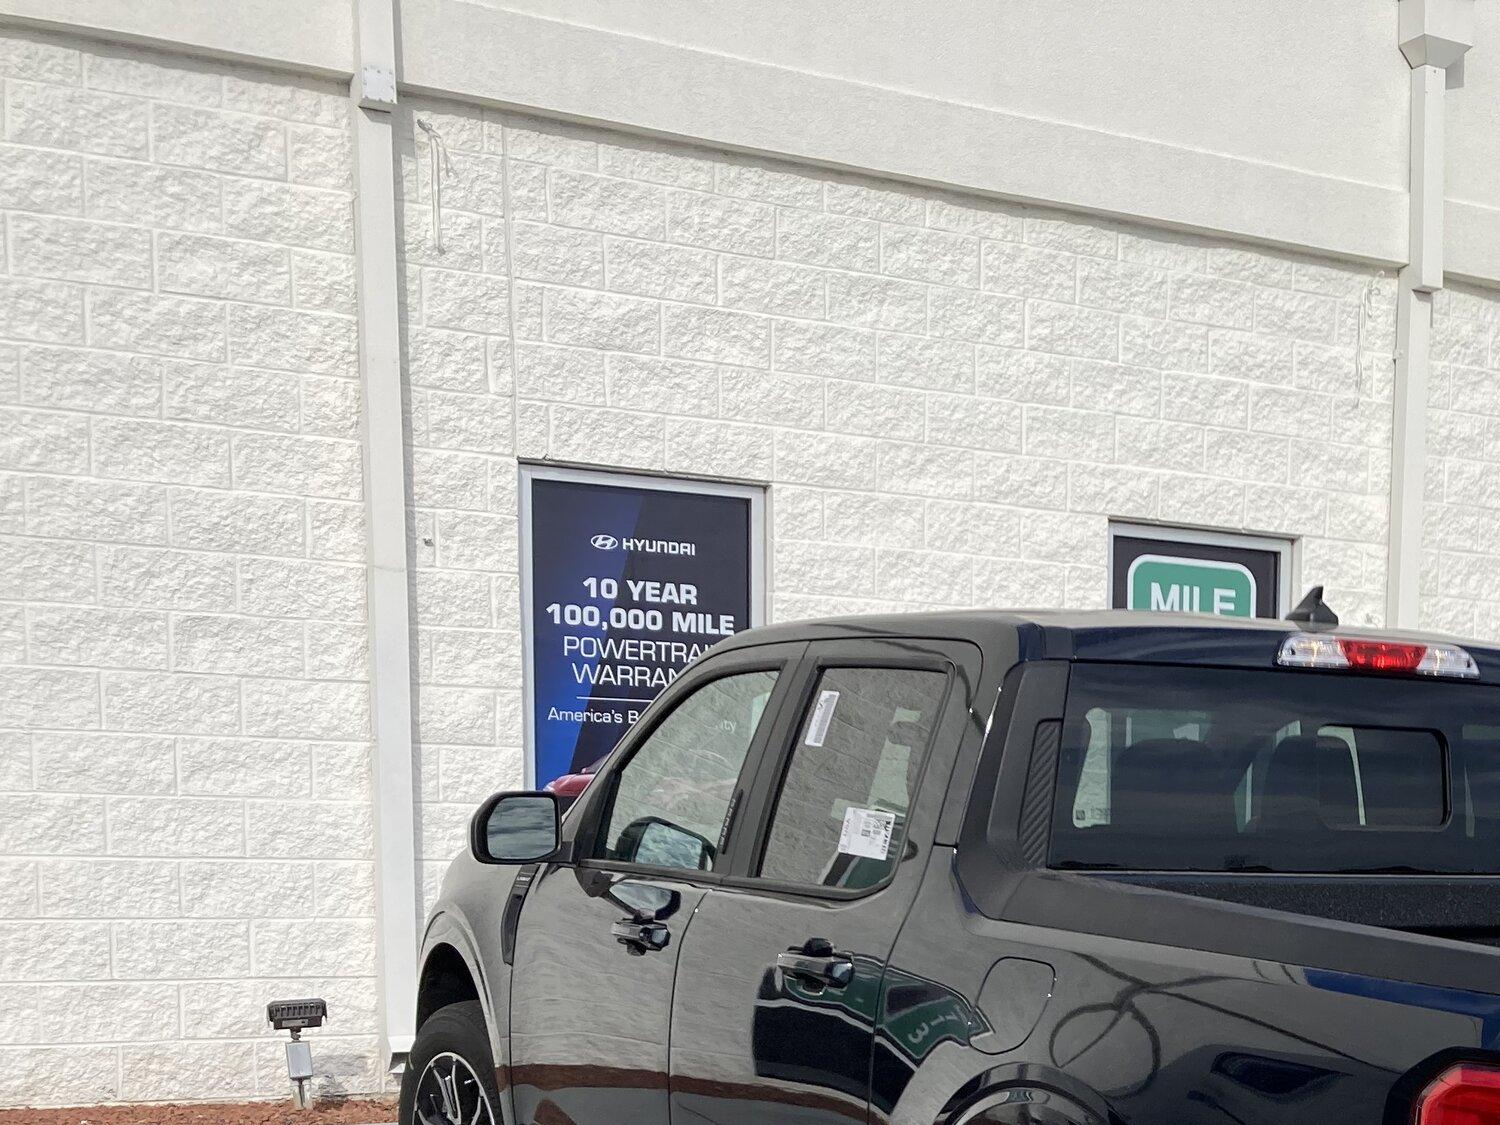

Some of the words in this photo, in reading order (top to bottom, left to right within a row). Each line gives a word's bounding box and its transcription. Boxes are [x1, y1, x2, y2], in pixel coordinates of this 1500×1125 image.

[622, 537, 696, 556] HYUNDAI
[583, 577, 618, 599] 10
[626, 580, 698, 605] YEAR
[546, 603, 663, 631] 100,000
[672, 611, 735, 636] MILE
[563, 636, 713, 664] POWERTRA
[572, 663, 678, 687] WARRAN
[548, 707, 623, 724] America's
